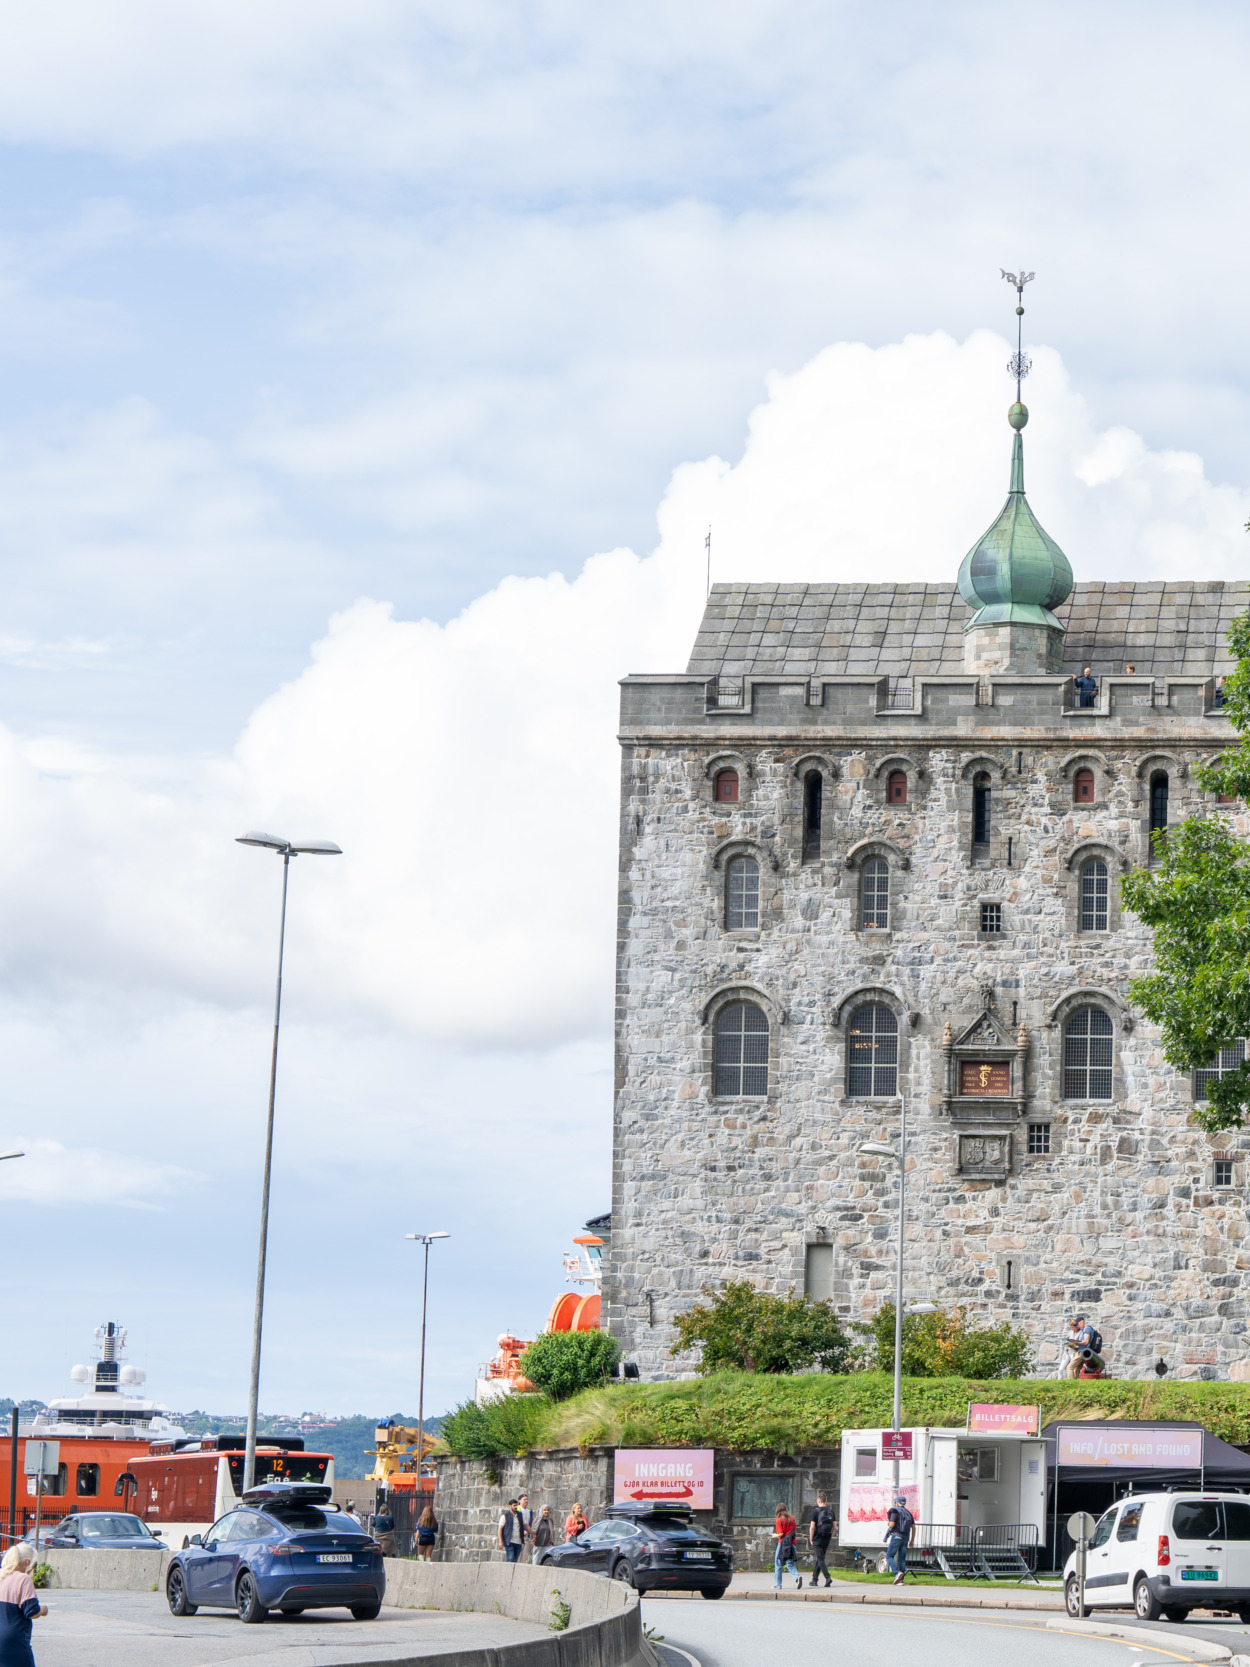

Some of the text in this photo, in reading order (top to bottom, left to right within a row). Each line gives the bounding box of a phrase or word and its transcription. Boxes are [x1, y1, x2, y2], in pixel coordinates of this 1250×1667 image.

[975, 1413, 1034, 1423] BILLETTSALG
[1070, 1442, 1093, 1454] INFO
[1104, 1443, 1130, 1455] LOST
[1132, 1443, 1153, 1455] AND
[1156, 1444, 1191, 1456] FOUND
[273, 1459, 284, 1471] 12
[634, 1463, 694, 1477] INNGANG
[623, 1480, 704, 1488] GJØR KLAR BILLETT OG ID
[1197, 1571, 1217, 1579] 96942
